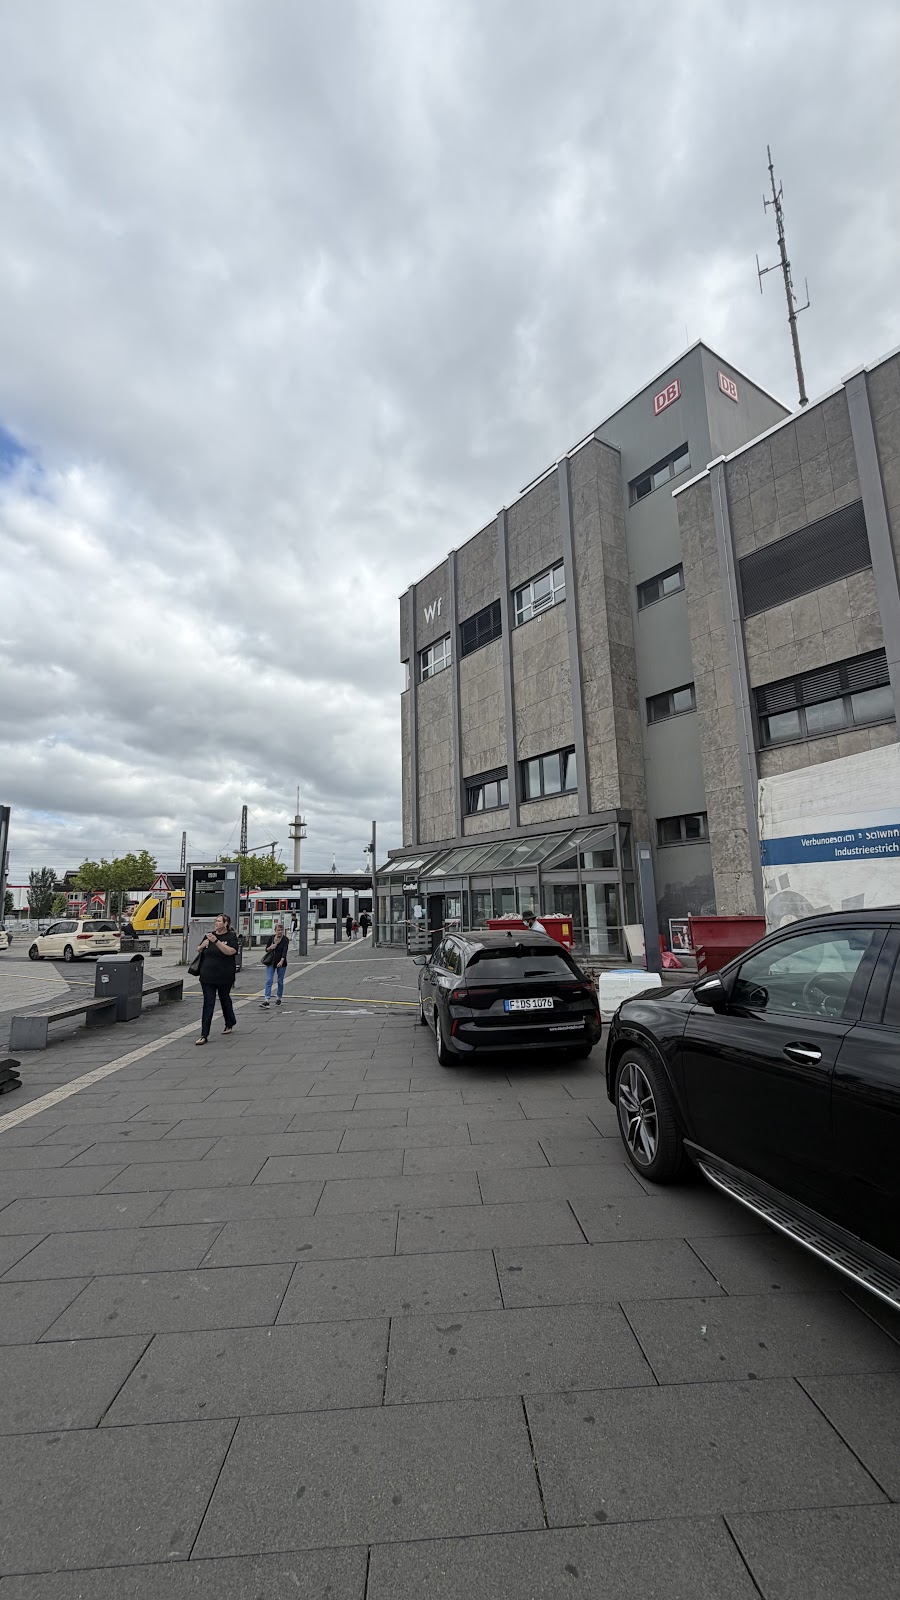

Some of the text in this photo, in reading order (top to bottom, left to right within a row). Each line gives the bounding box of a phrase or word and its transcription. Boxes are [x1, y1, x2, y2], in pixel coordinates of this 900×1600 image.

[721, 376, 736, 396] DB
[656, 384, 677, 410] DB
[423, 596, 443, 624] Wf
[835, 842, 899, 856] Industrieestrich
[520, 999, 531, 1008] DS
[533, 998, 553, 1008] 1076
